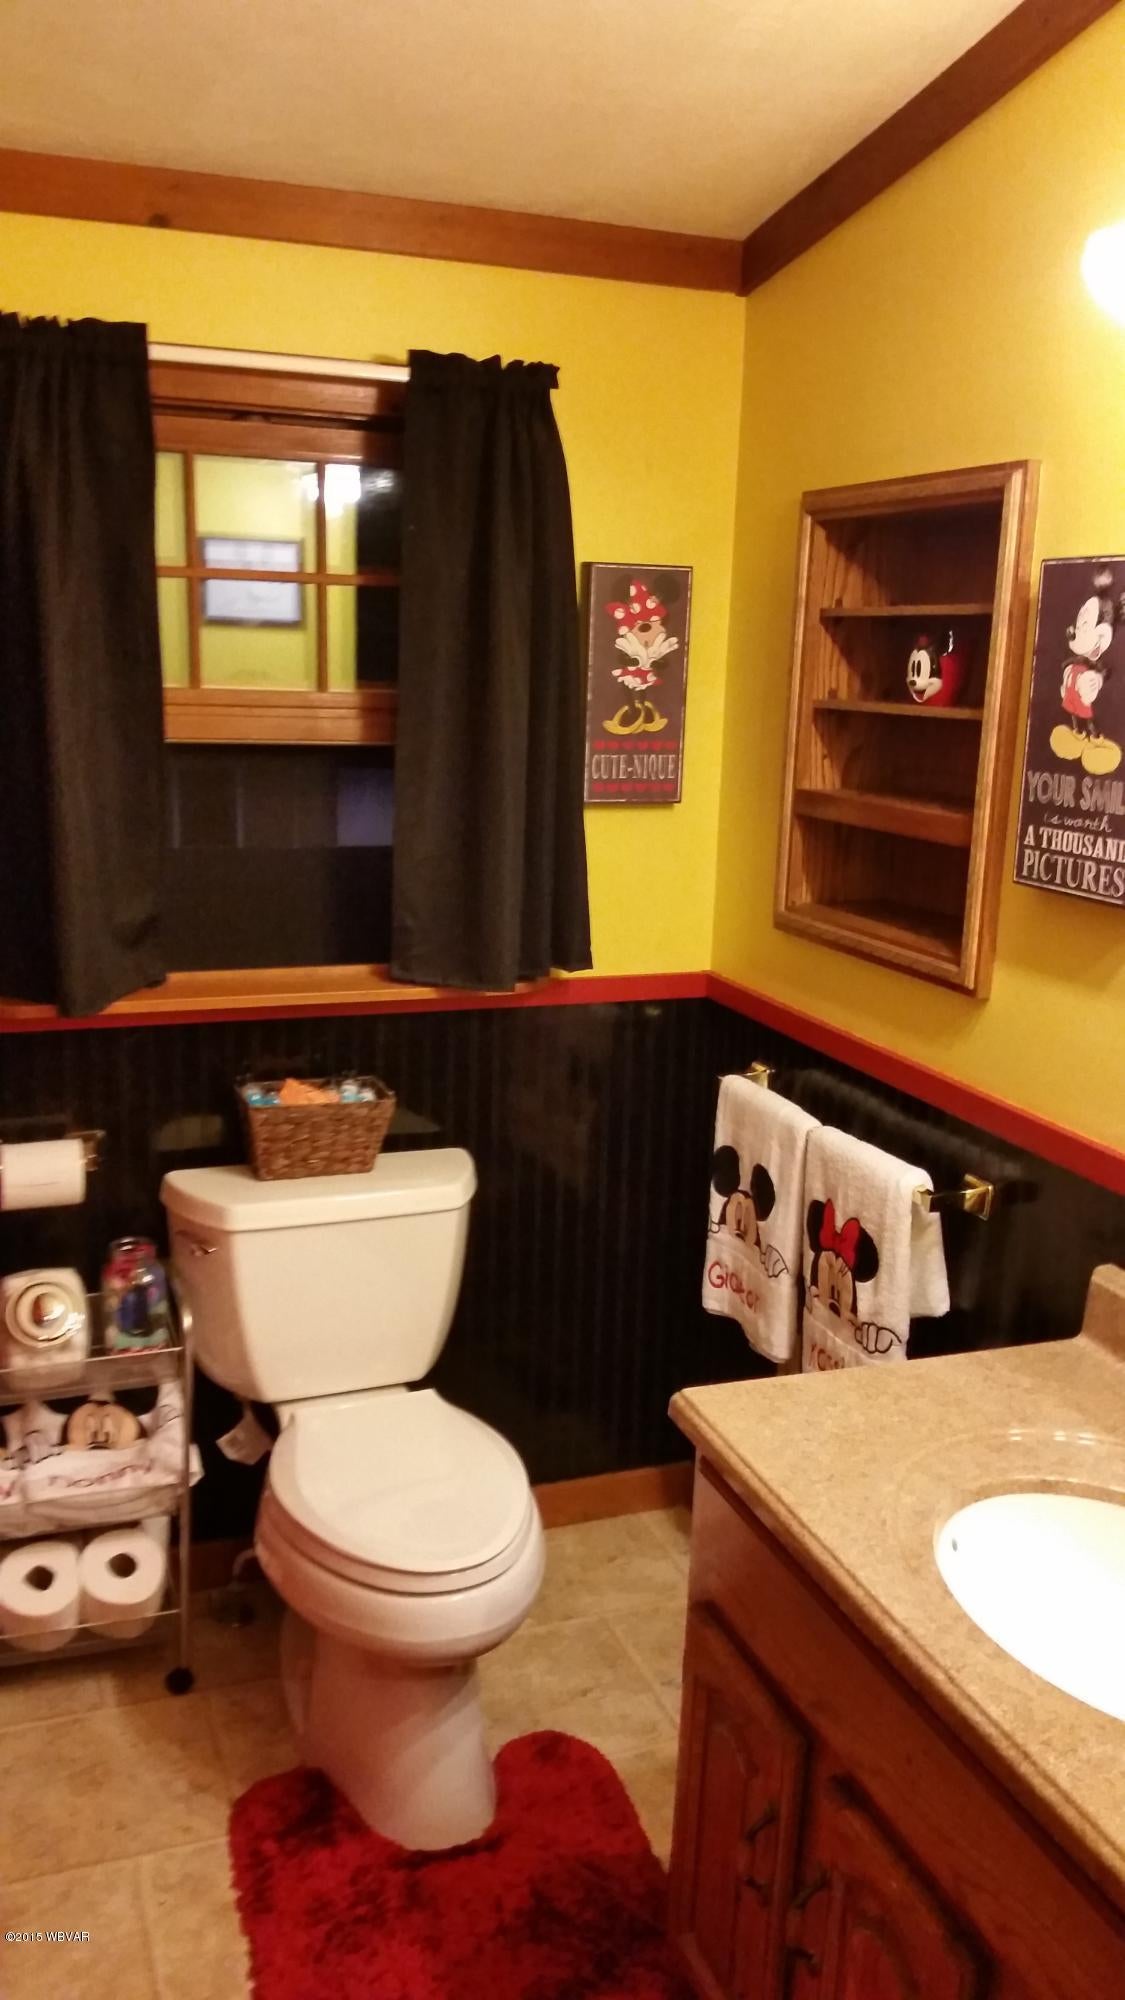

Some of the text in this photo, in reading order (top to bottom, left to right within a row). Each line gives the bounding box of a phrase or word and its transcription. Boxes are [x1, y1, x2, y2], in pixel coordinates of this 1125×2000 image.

[591, 753, 677, 781] CUTE-NIQUE
[1026, 769, 1125, 816] YOUR SMIL
[1043, 811, 1112, 833] is worth
[1023, 824, 1125, 864] A THOUSAND
[1022, 848, 1125, 898] PICTURES
